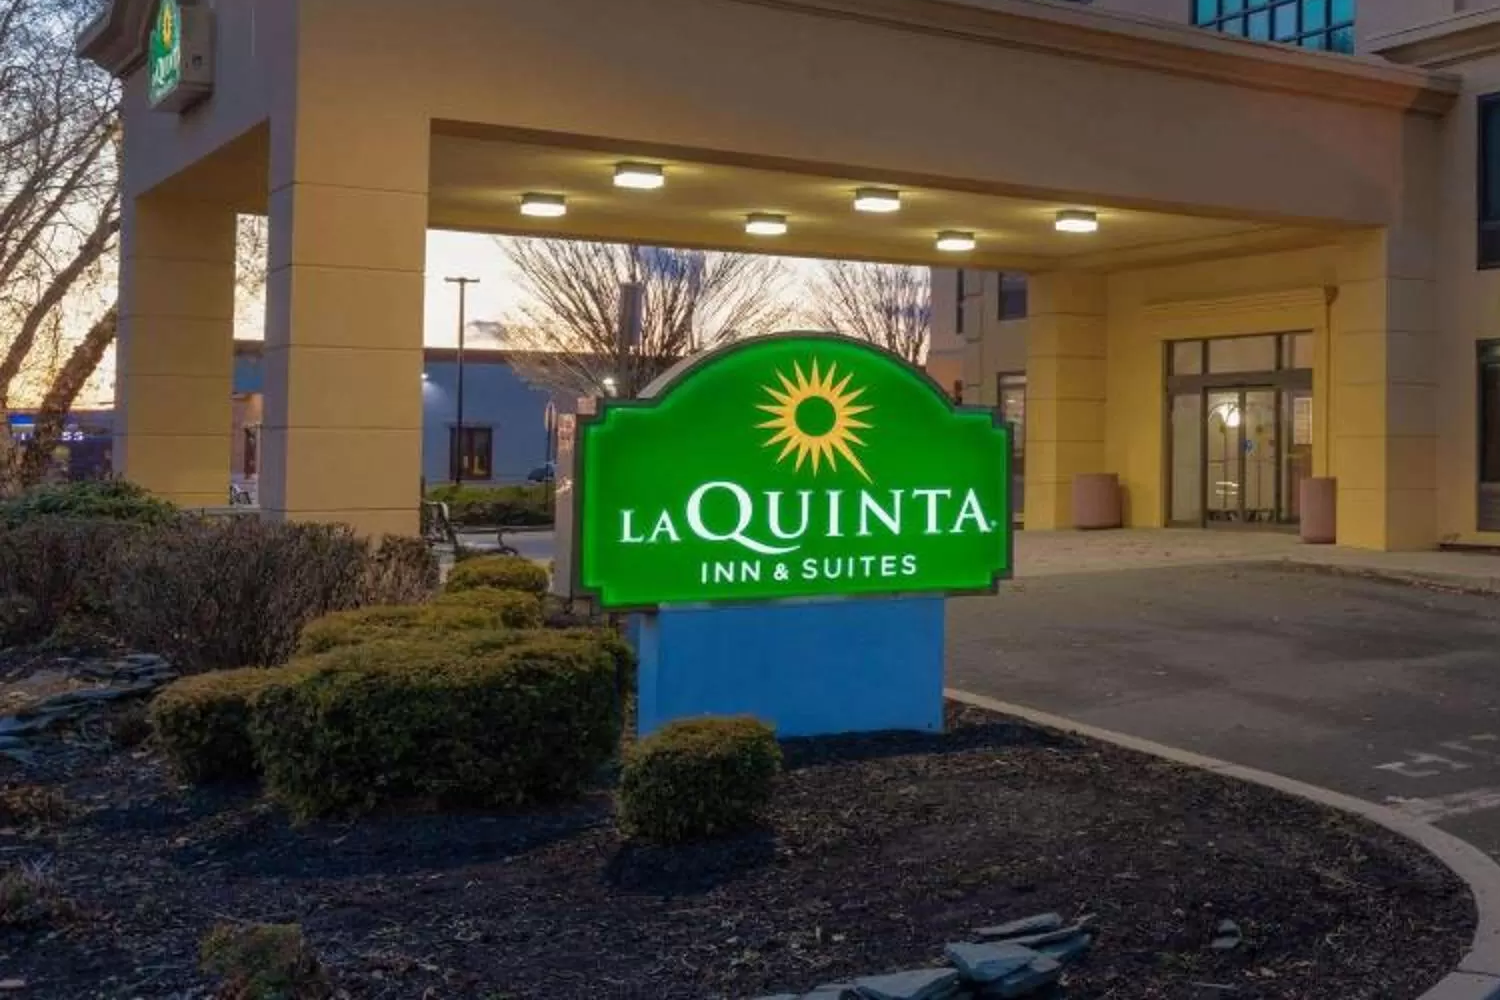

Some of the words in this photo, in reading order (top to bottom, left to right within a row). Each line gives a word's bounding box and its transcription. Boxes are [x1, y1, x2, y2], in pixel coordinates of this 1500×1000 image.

[618, 508, 681, 544] LA
[686, 481, 993, 555] QUINTA
[701, 560, 761, 584] INN
[773, 563, 789, 582] &
[801, 555, 917, 580] SUITES
